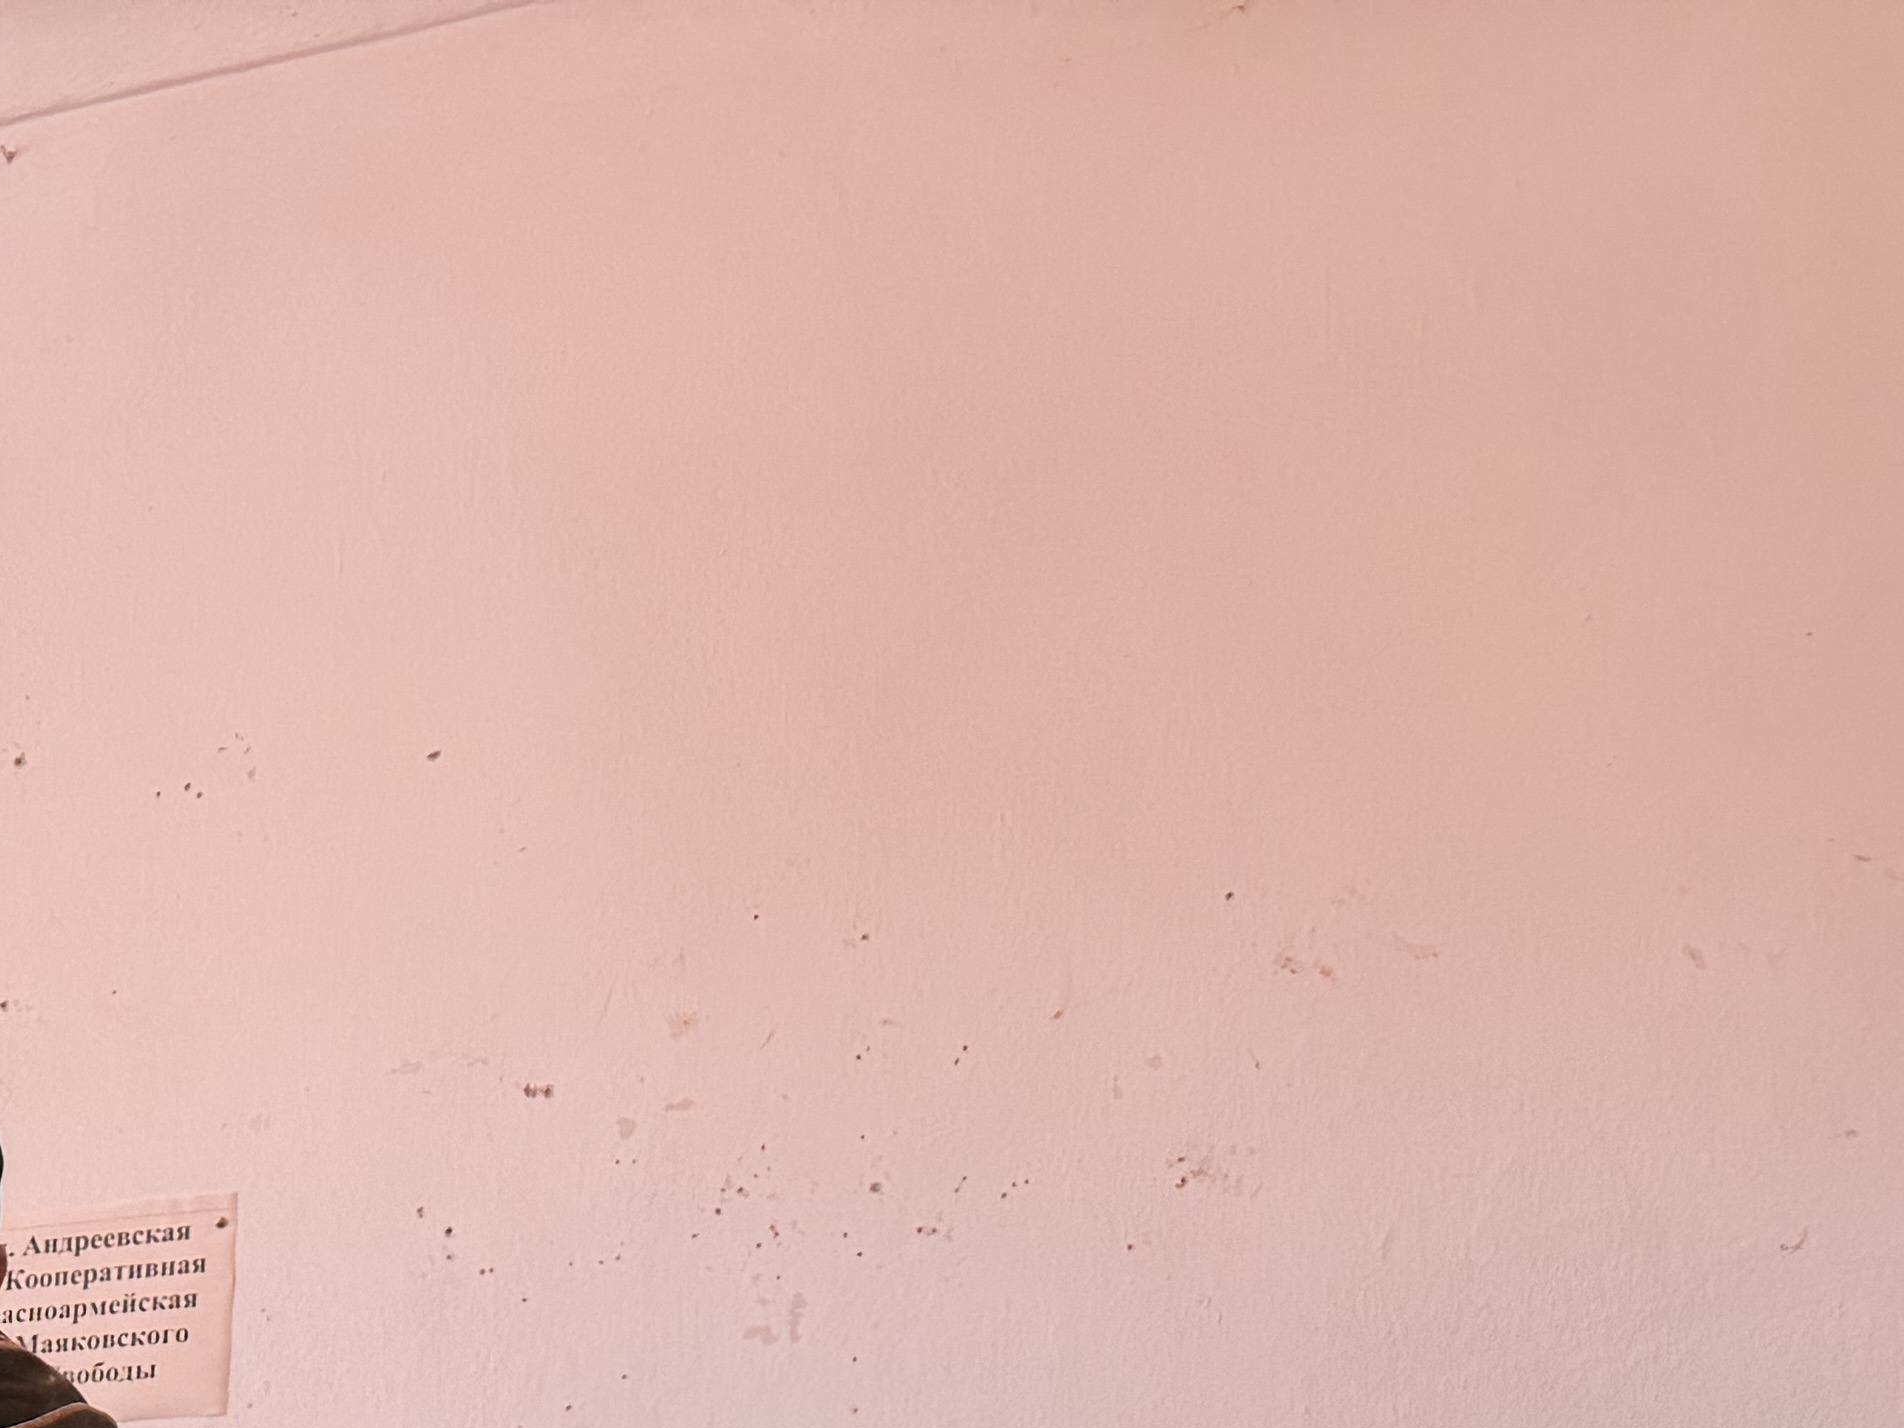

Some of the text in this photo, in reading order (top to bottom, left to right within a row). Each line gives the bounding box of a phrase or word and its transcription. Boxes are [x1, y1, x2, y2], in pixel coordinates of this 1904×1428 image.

[23, 1225, 191, 1257] Андреевская
[5, 1257, 206, 1290] Кооперативная
[58, 1362, 157, 1384] вободы
